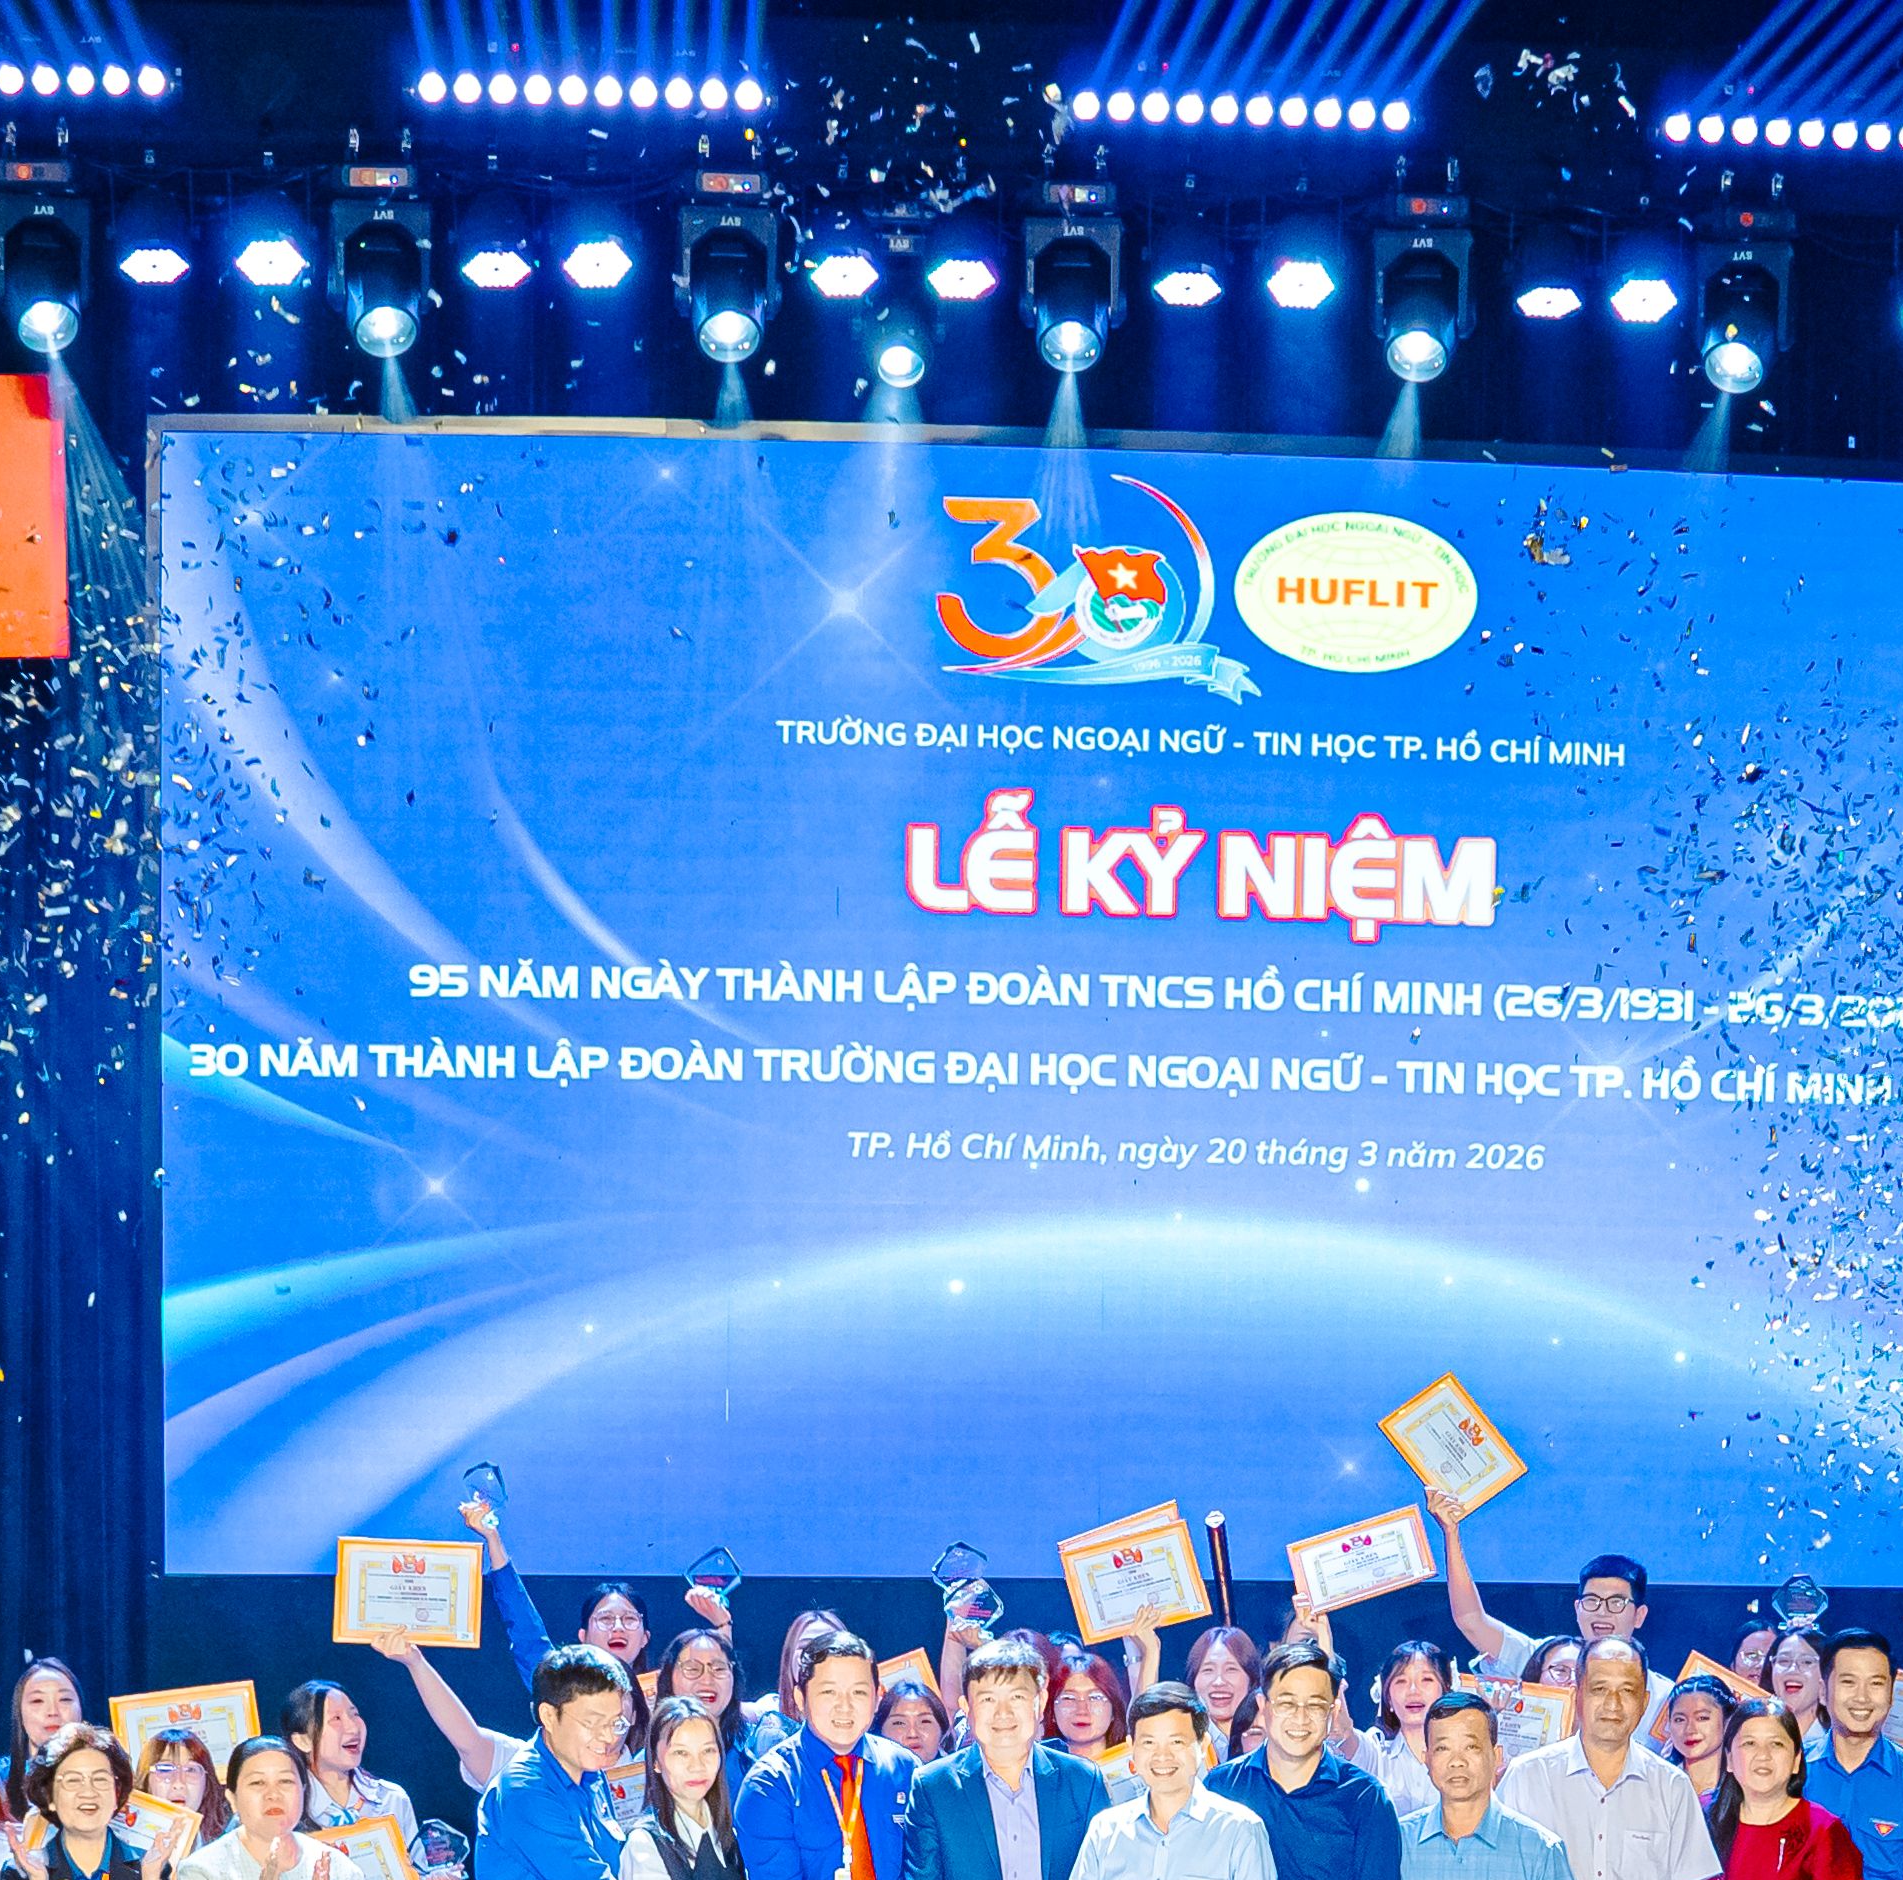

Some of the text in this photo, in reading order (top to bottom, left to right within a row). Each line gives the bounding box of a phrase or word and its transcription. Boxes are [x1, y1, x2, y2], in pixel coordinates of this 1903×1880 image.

[1276, 576, 1440, 609] HUFLIT
[776, 716, 907, 749] TRƯỜNG
[915, 723, 969, 753] ĐẠI
[977, 725, 1045, 755] HỌC
[1053, 727, 1150, 758] NGOẠI
[1159, 723, 1227, 755] NGỮ
[1253, 732, 1303, 757] TIN
[1311, 733, 1378, 763] HỌC
[1384, 736, 1429, 760] TP.
[1436, 729, 1482, 762] HỒ
[1491, 733, 1541, 764] CHÍ
[1548, 742, 1626, 768] MINH
[906, 788, 1500, 943] LỄ KỶ NIỆM
[409, 964, 470, 998] 95
[479, 958, 579, 1000] NĂM
[590, 958, 709, 1001] NGÀY
[716, 958, 865, 1003] THÀNH
[874, 962, 957, 1012] LẬP
[965, 963, 1091, 1006] ĐOÀN
[1099, 976, 1215, 1010] TNCS
[1225, 964, 1287, 1012] HỒ
[1295, 970, 1363, 1014] CHÍ
[1374, 981, 1483, 1017] MINH
[1494, 982, 1695, 1024] (26/3/1931
[189, 1043, 250, 1078] 30
[259, 1036, 359, 1079] NĂM
[367, 1036, 515, 1080] THÀNH
[527, 1036, 609, 1089] LẬP
[619, 1038, 745, 1083] ĐOÀN
[754, 1041, 936, 1086] TRƯỜNG
[945, 1050, 1019, 1095] ĐẠI
[1030, 1053, 1117, 1096] HỌC
[1128, 1054, 1261, 1099] NGOẠI
[1272, 1051, 1364, 1092] NGỮ
[1397, 1060, 1467, 1097] TIN
[1477, 1062, 1561, 1104] HỌC
[1569, 1064, 1632, 1101] TP.
[1643, 1055, 1697, 1101] HỒ
[1710, 1061, 1775, 1103] CHÍ
[1787, 1076, 1895, 1107] MINH
[848, 1129, 1546, 1174] TP. Hồ Chí Minh, ngày 20 tháng 3 năm 2026
